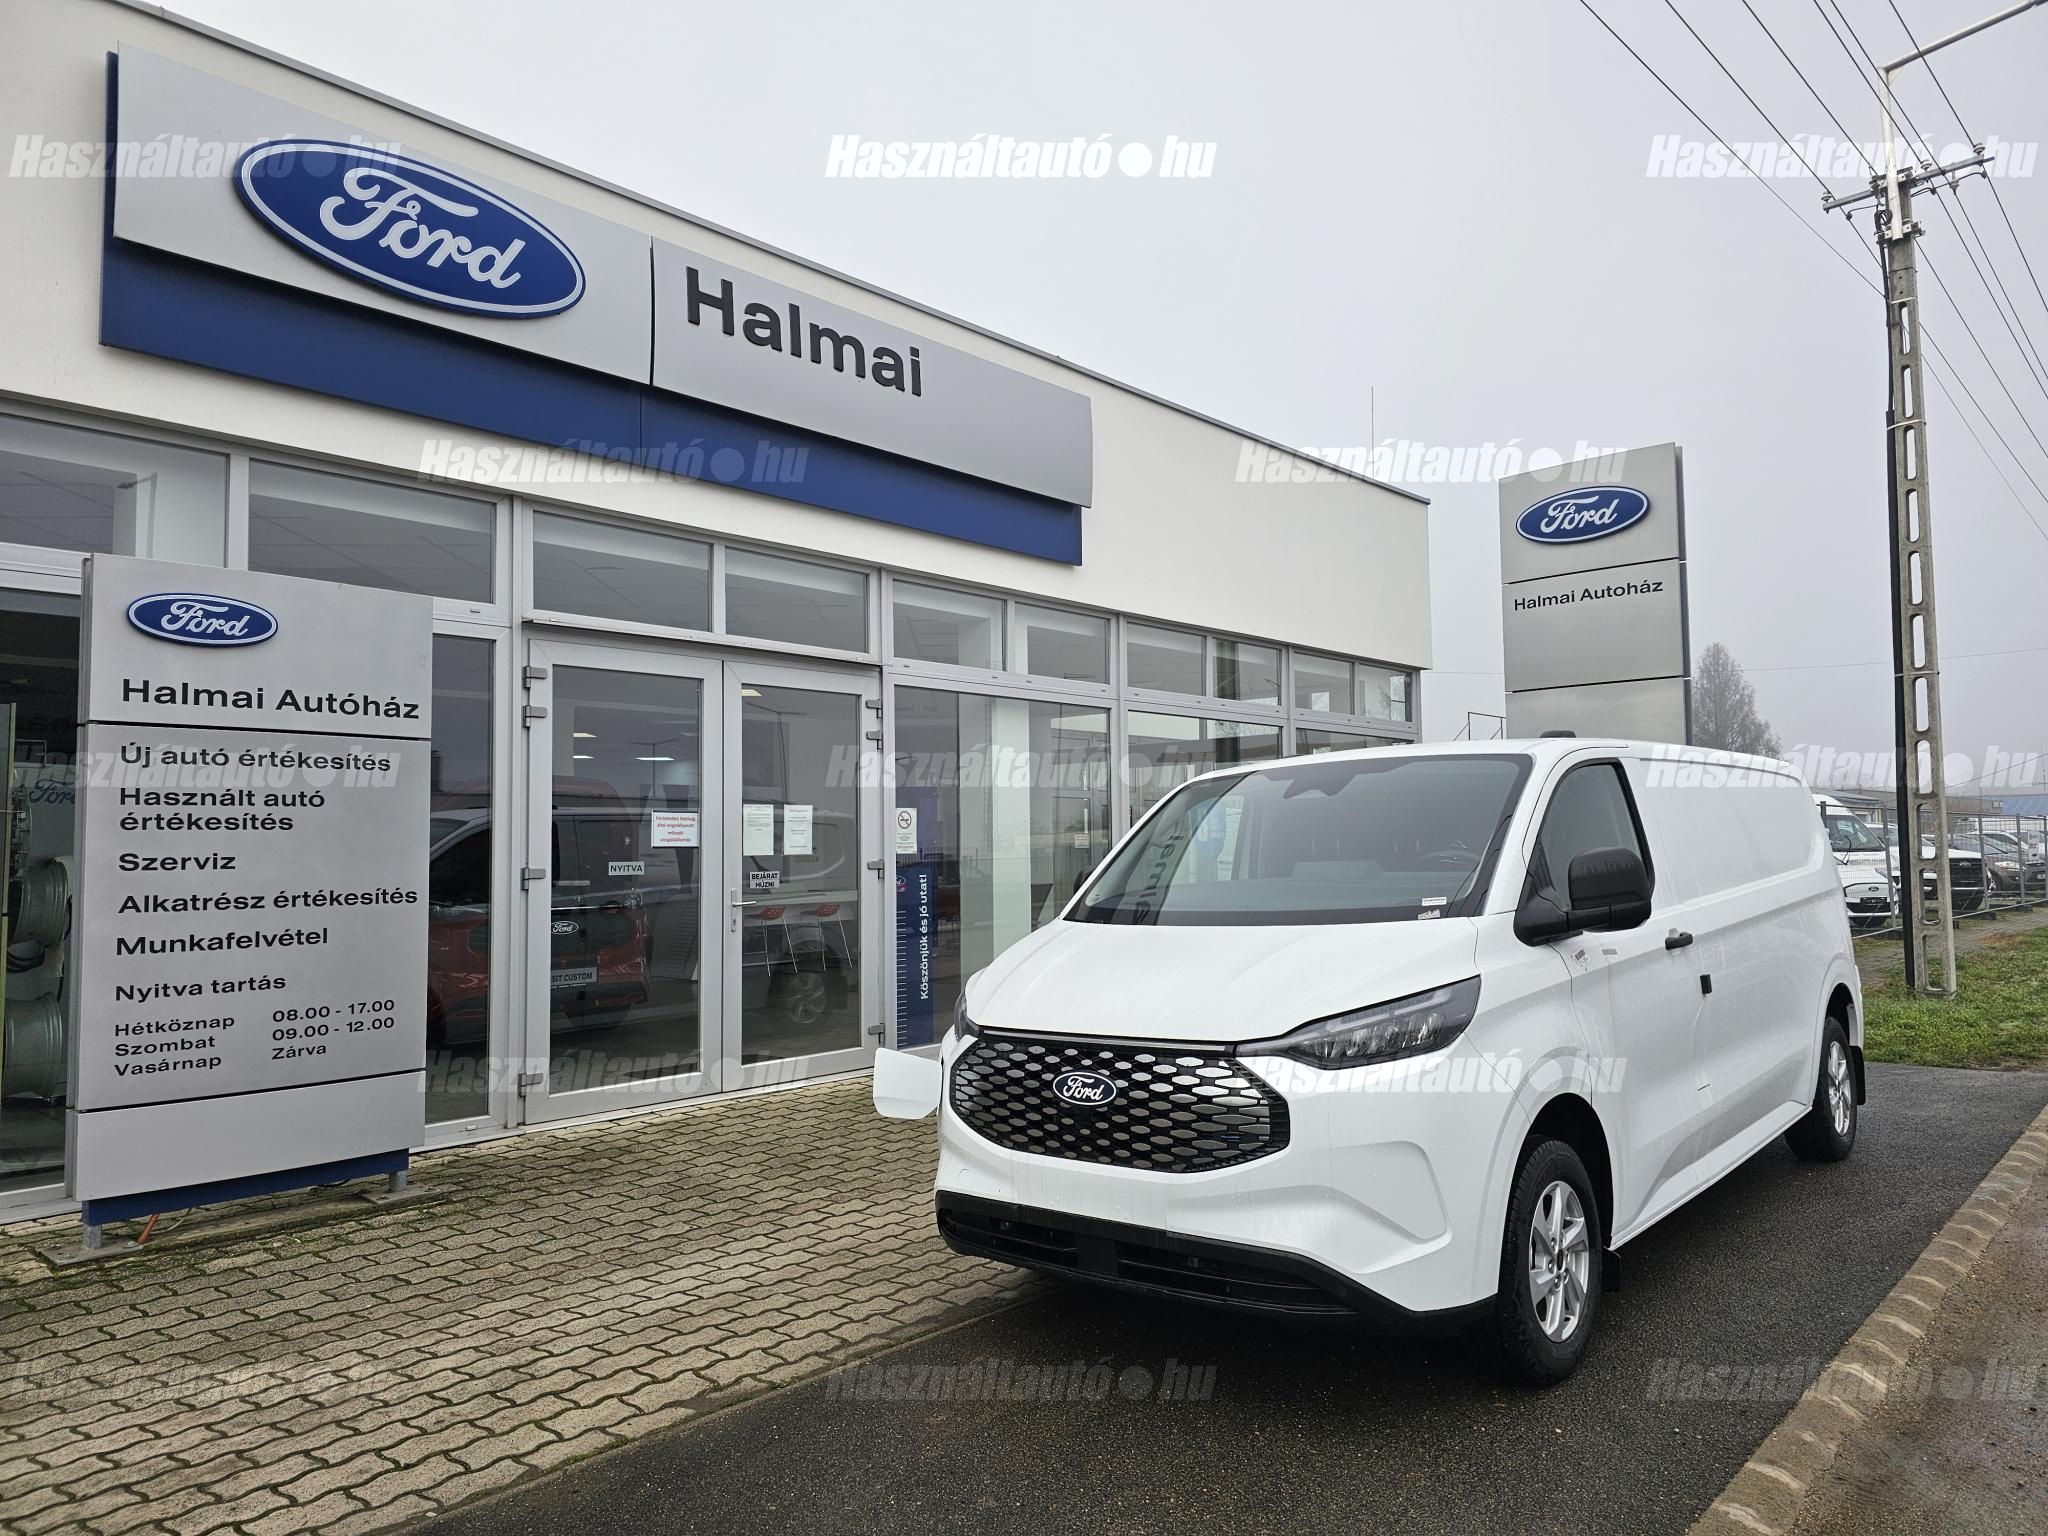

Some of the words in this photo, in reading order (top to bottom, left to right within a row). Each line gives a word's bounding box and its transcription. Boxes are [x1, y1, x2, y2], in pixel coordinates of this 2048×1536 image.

[319, 167, 526, 289] Ford
[686, 266, 922, 396] Halmai
[1540, 495, 1620, 533] Ford
[1514, 588, 1575, 611] Halmai
[160, 600, 249, 637] Ford
[122, 678, 264, 710] Halmai
[275, 688, 420, 720] Autóház
[120, 741, 151, 769] Új
[160, 747, 230, 767] autó
[238, 748, 391, 772] értékesítés
[119, 786, 256, 807] Használt
[263, 788, 326, 808] autó
[119, 811, 294, 831] értékesítés
[118, 852, 236, 872] Szerviz
[610, 864, 643, 873] NYITVA
[751, 872, 778, 880] BEJÁRAT
[117, 891, 266, 914] Alkatrész
[272, 887, 418, 909] értékesítés
[919, 874, 928, 905] utat!
[919, 907, 929, 917] jó
[919, 918, 928, 934] és
[116, 927, 328, 956] Munkafelvétel
[552, 921, 573, 933] Ford
[563, 972, 593, 981] CUSTOM
[920, 935, 929, 1000] Köszönjük
[115, 982, 203, 1004] Nyitva
[210, 974, 286, 994] tartás
[114, 1014, 235, 1038] Hétköznap
[272, 1005, 331, 1023] 08.00
[347, 999, 395, 1015] 17.00
[114, 1036, 216, 1058] Szombat
[272, 1023, 330, 1042] 09.00
[345, 1016, 395, 1033] 12.00
[113, 1053, 222, 1077] Vasárnap
[271, 1041, 327, 1061] Zárva
[1063, 1075, 1105, 1101] Ford
